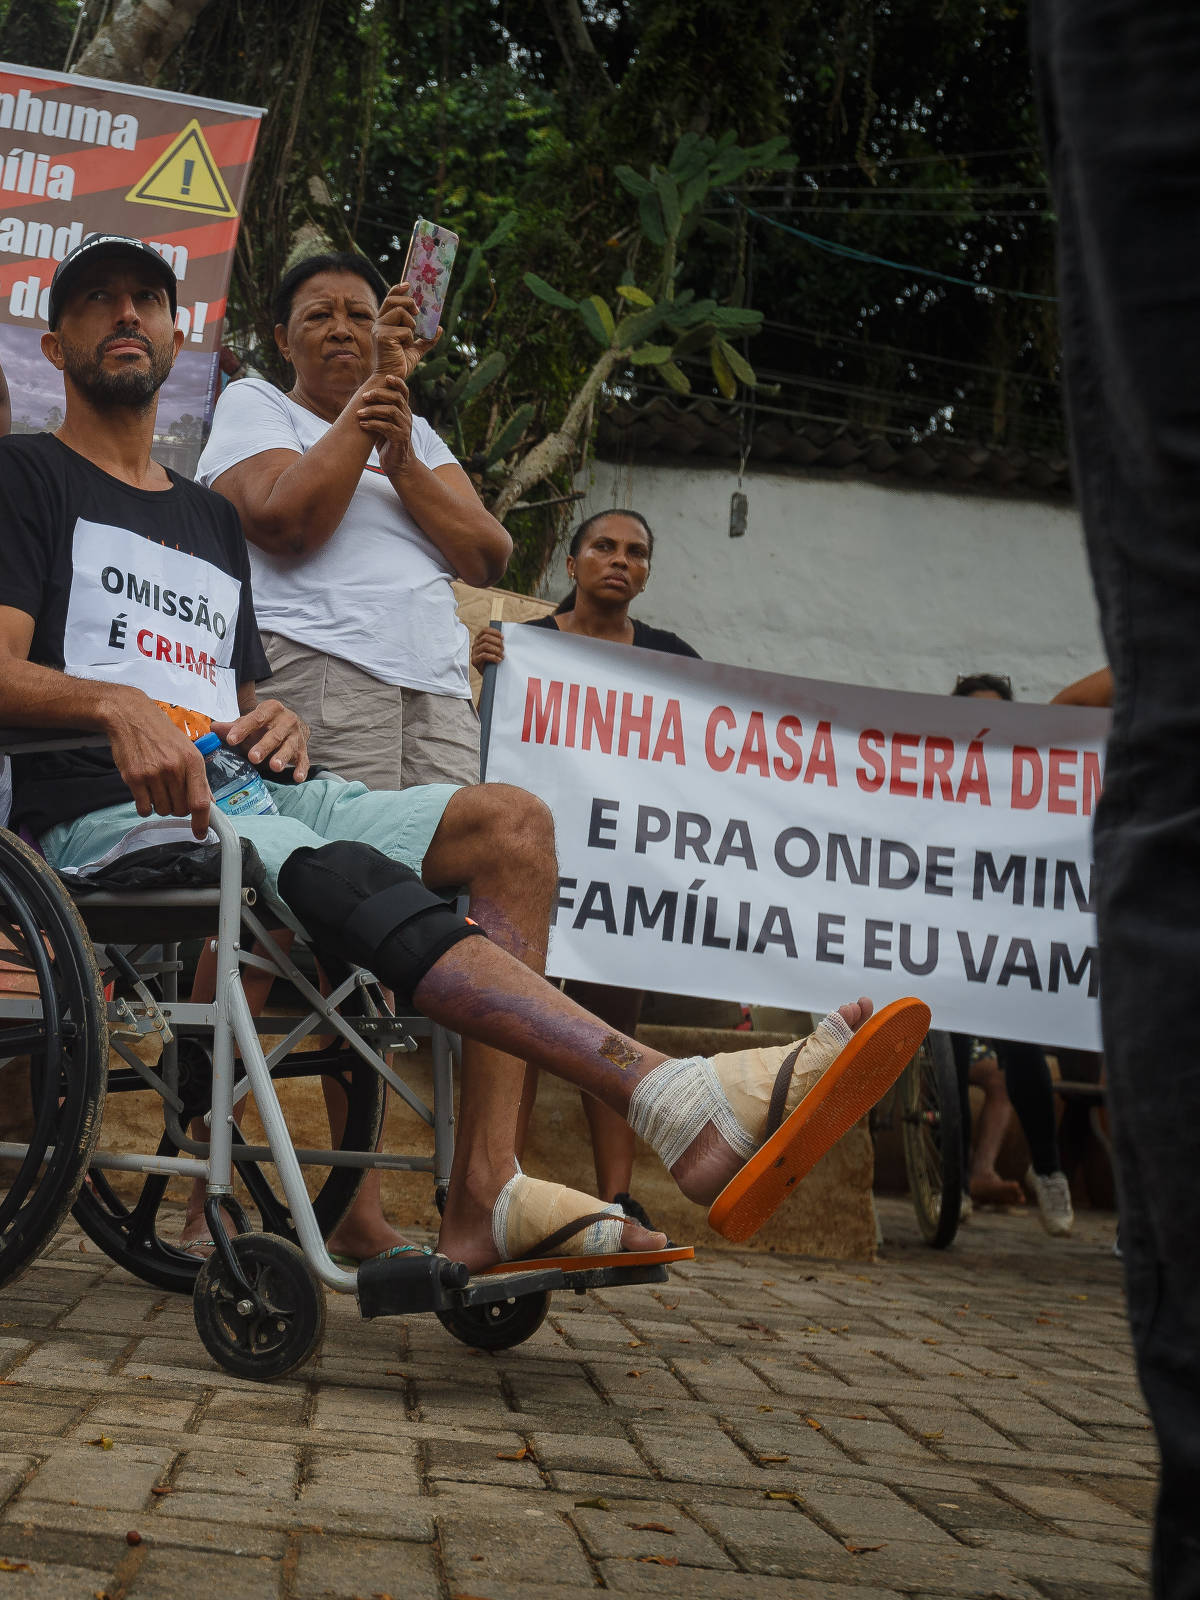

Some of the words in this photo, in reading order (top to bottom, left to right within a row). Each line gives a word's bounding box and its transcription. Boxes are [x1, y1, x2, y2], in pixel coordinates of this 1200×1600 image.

[101, 565, 227, 641] OMISSÃO
[108, 612, 128, 650] É
[136, 628, 217, 688] CRIME
[521, 676, 686, 766] MINHA
[704, 705, 838, 788] CASA
[856, 727, 992, 807] SERÁ
[587, 797, 620, 850] E
[634, 804, 758, 871] PRA
[774, 826, 956, 897] ONDE
[550, 876, 798, 959] FAMÍLIA
[815, 911, 846, 965] E
[863, 917, 940, 976] EU
